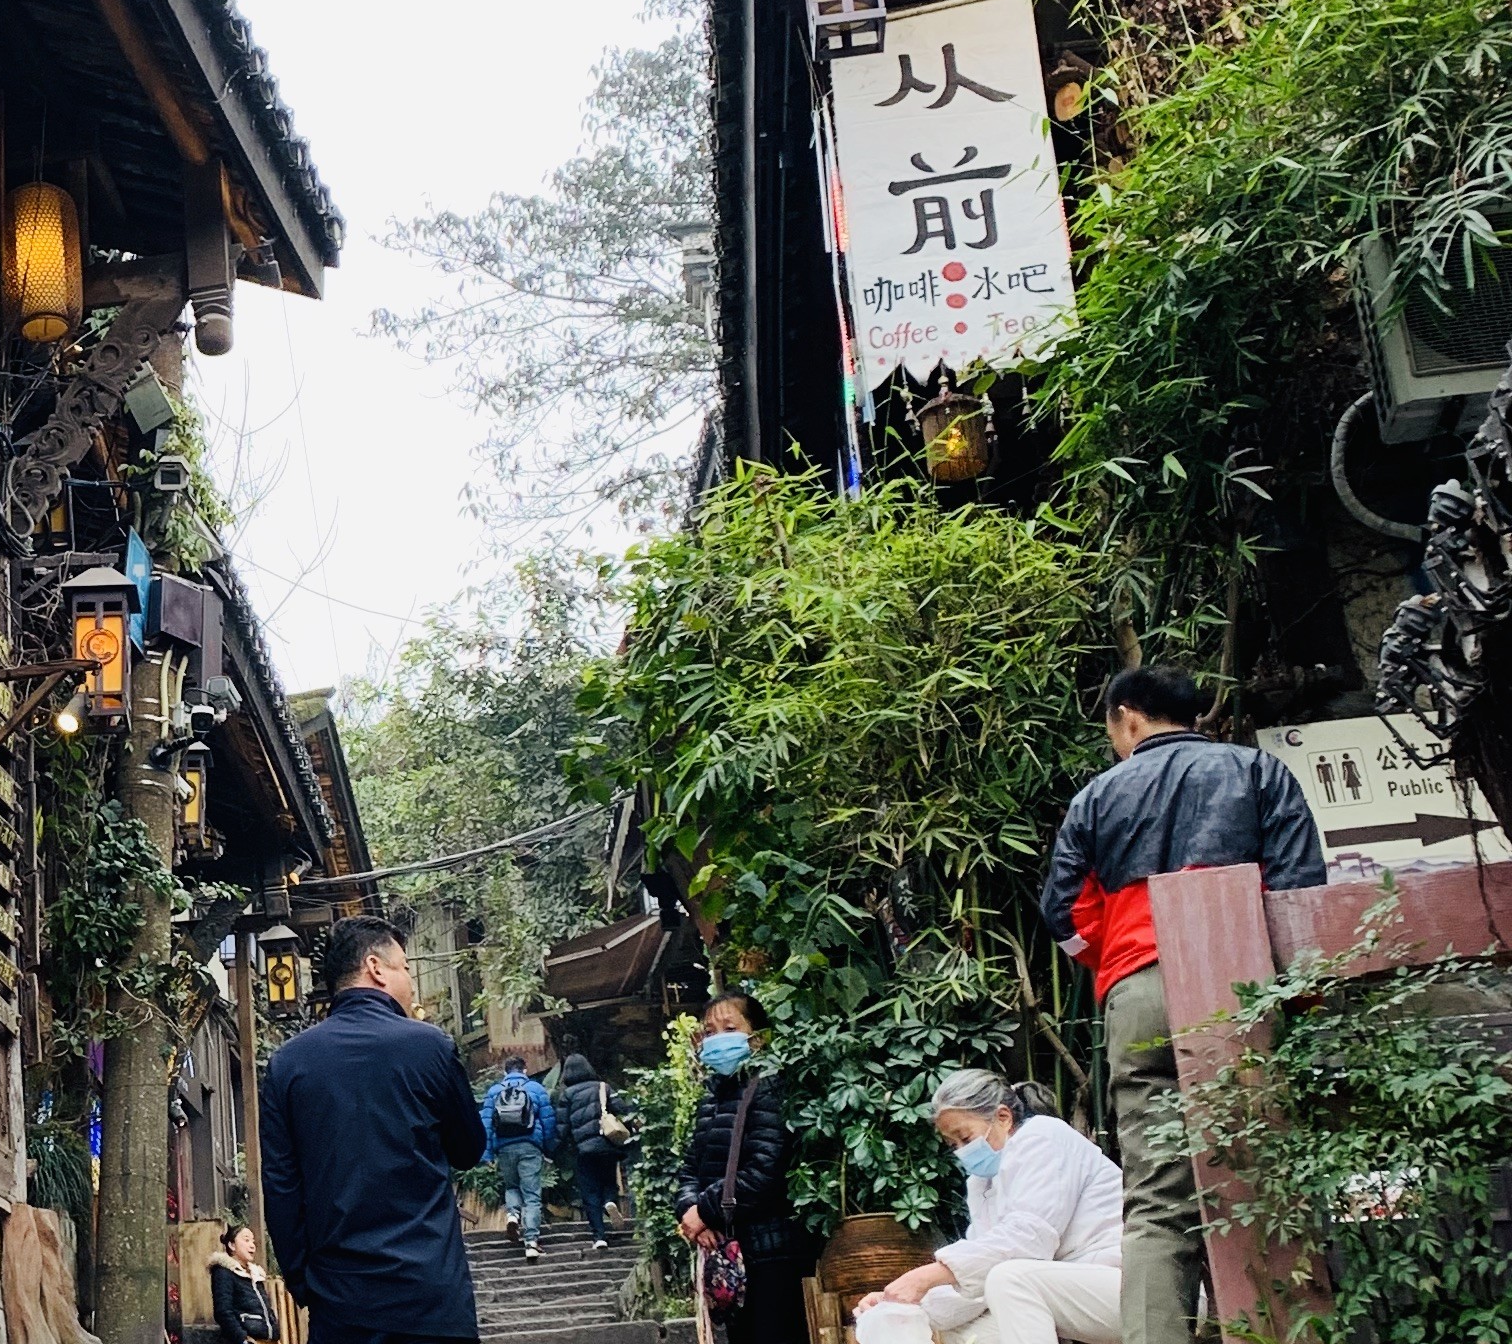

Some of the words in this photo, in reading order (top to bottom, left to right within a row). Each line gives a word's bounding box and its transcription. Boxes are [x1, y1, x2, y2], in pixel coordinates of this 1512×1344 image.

[874, 42, 1018, 256] 从前
[863, 269, 942, 315] 咖啡
[971, 263, 1055, 300] 水吧
[869, 321, 939, 350] Coffee
[1387, 777, 1444, 797] Public
